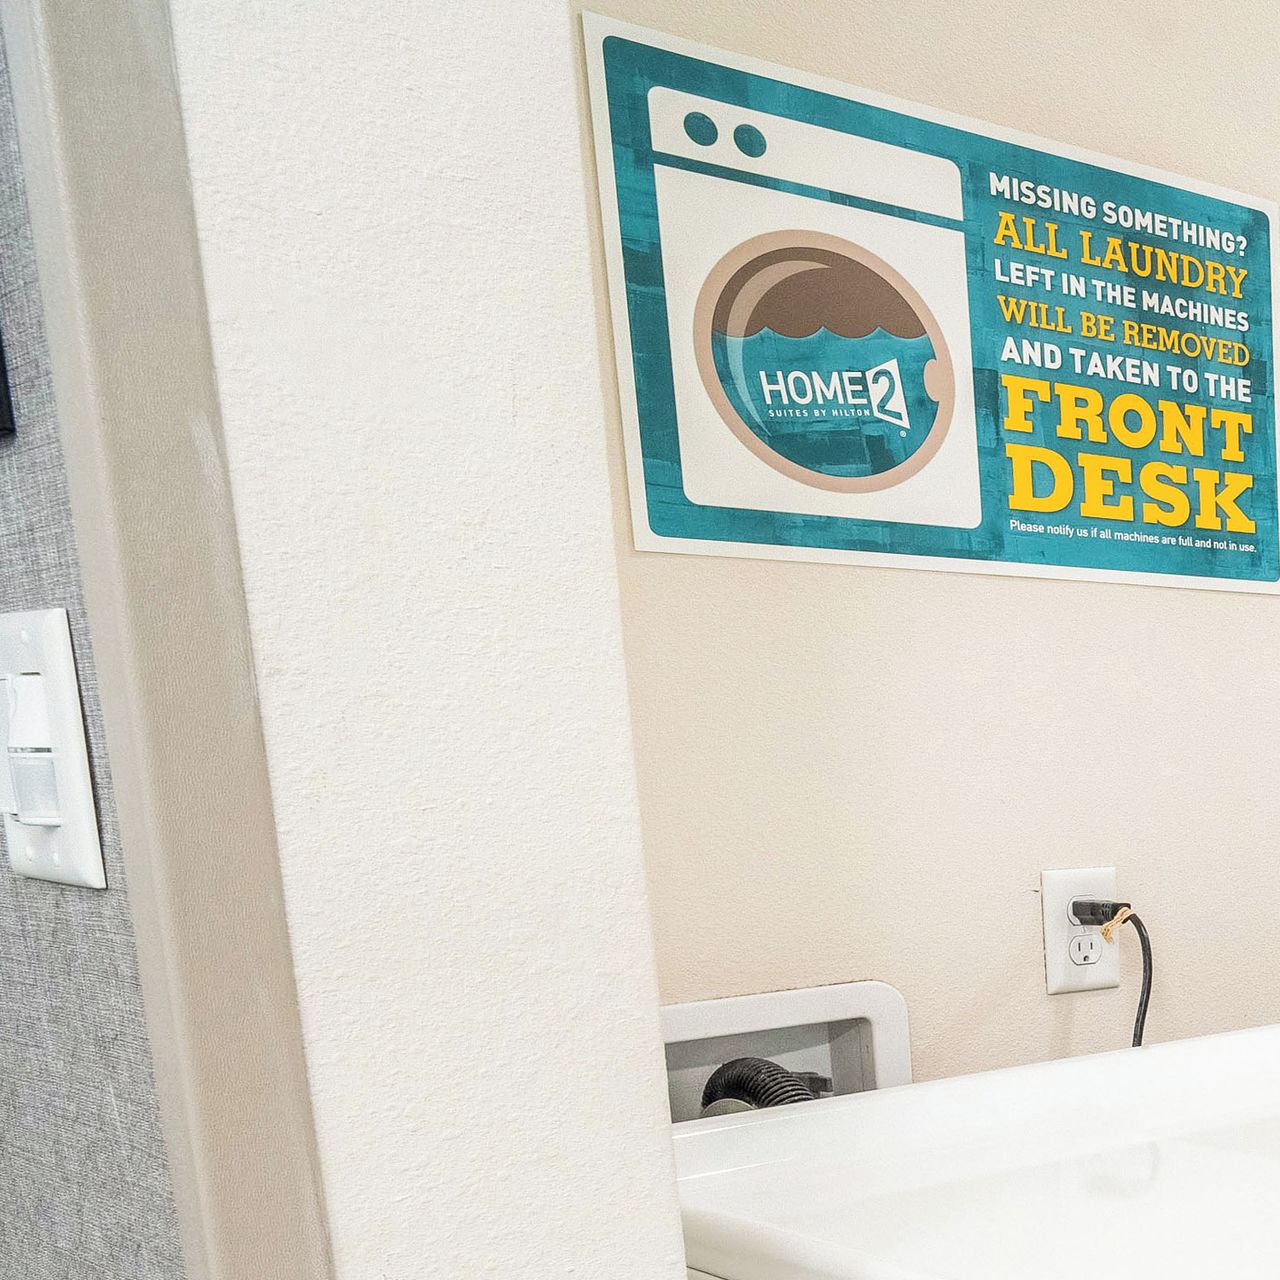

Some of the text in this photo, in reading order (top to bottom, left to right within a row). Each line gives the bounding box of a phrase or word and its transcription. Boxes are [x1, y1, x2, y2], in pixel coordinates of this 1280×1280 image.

[989, 172, 1248, 257] MISSING SOMETHING?
[994, 211, 1248, 299] ALL LAUNDRY
[994, 258, 1250, 332] LEFT IN THE MACHINES
[997, 295, 1251, 367] WILL BE REMOVED
[1000, 336, 1252, 403] AND TAKEN TO THE
[768, 408, 871, 418] SUITES BY HILTON
[1001, 374, 1254, 463] FRONT
[1005, 442, 1257, 534] DESK
[1009, 519, 1258, 553] Please notify us if all machines are full and not in use.
